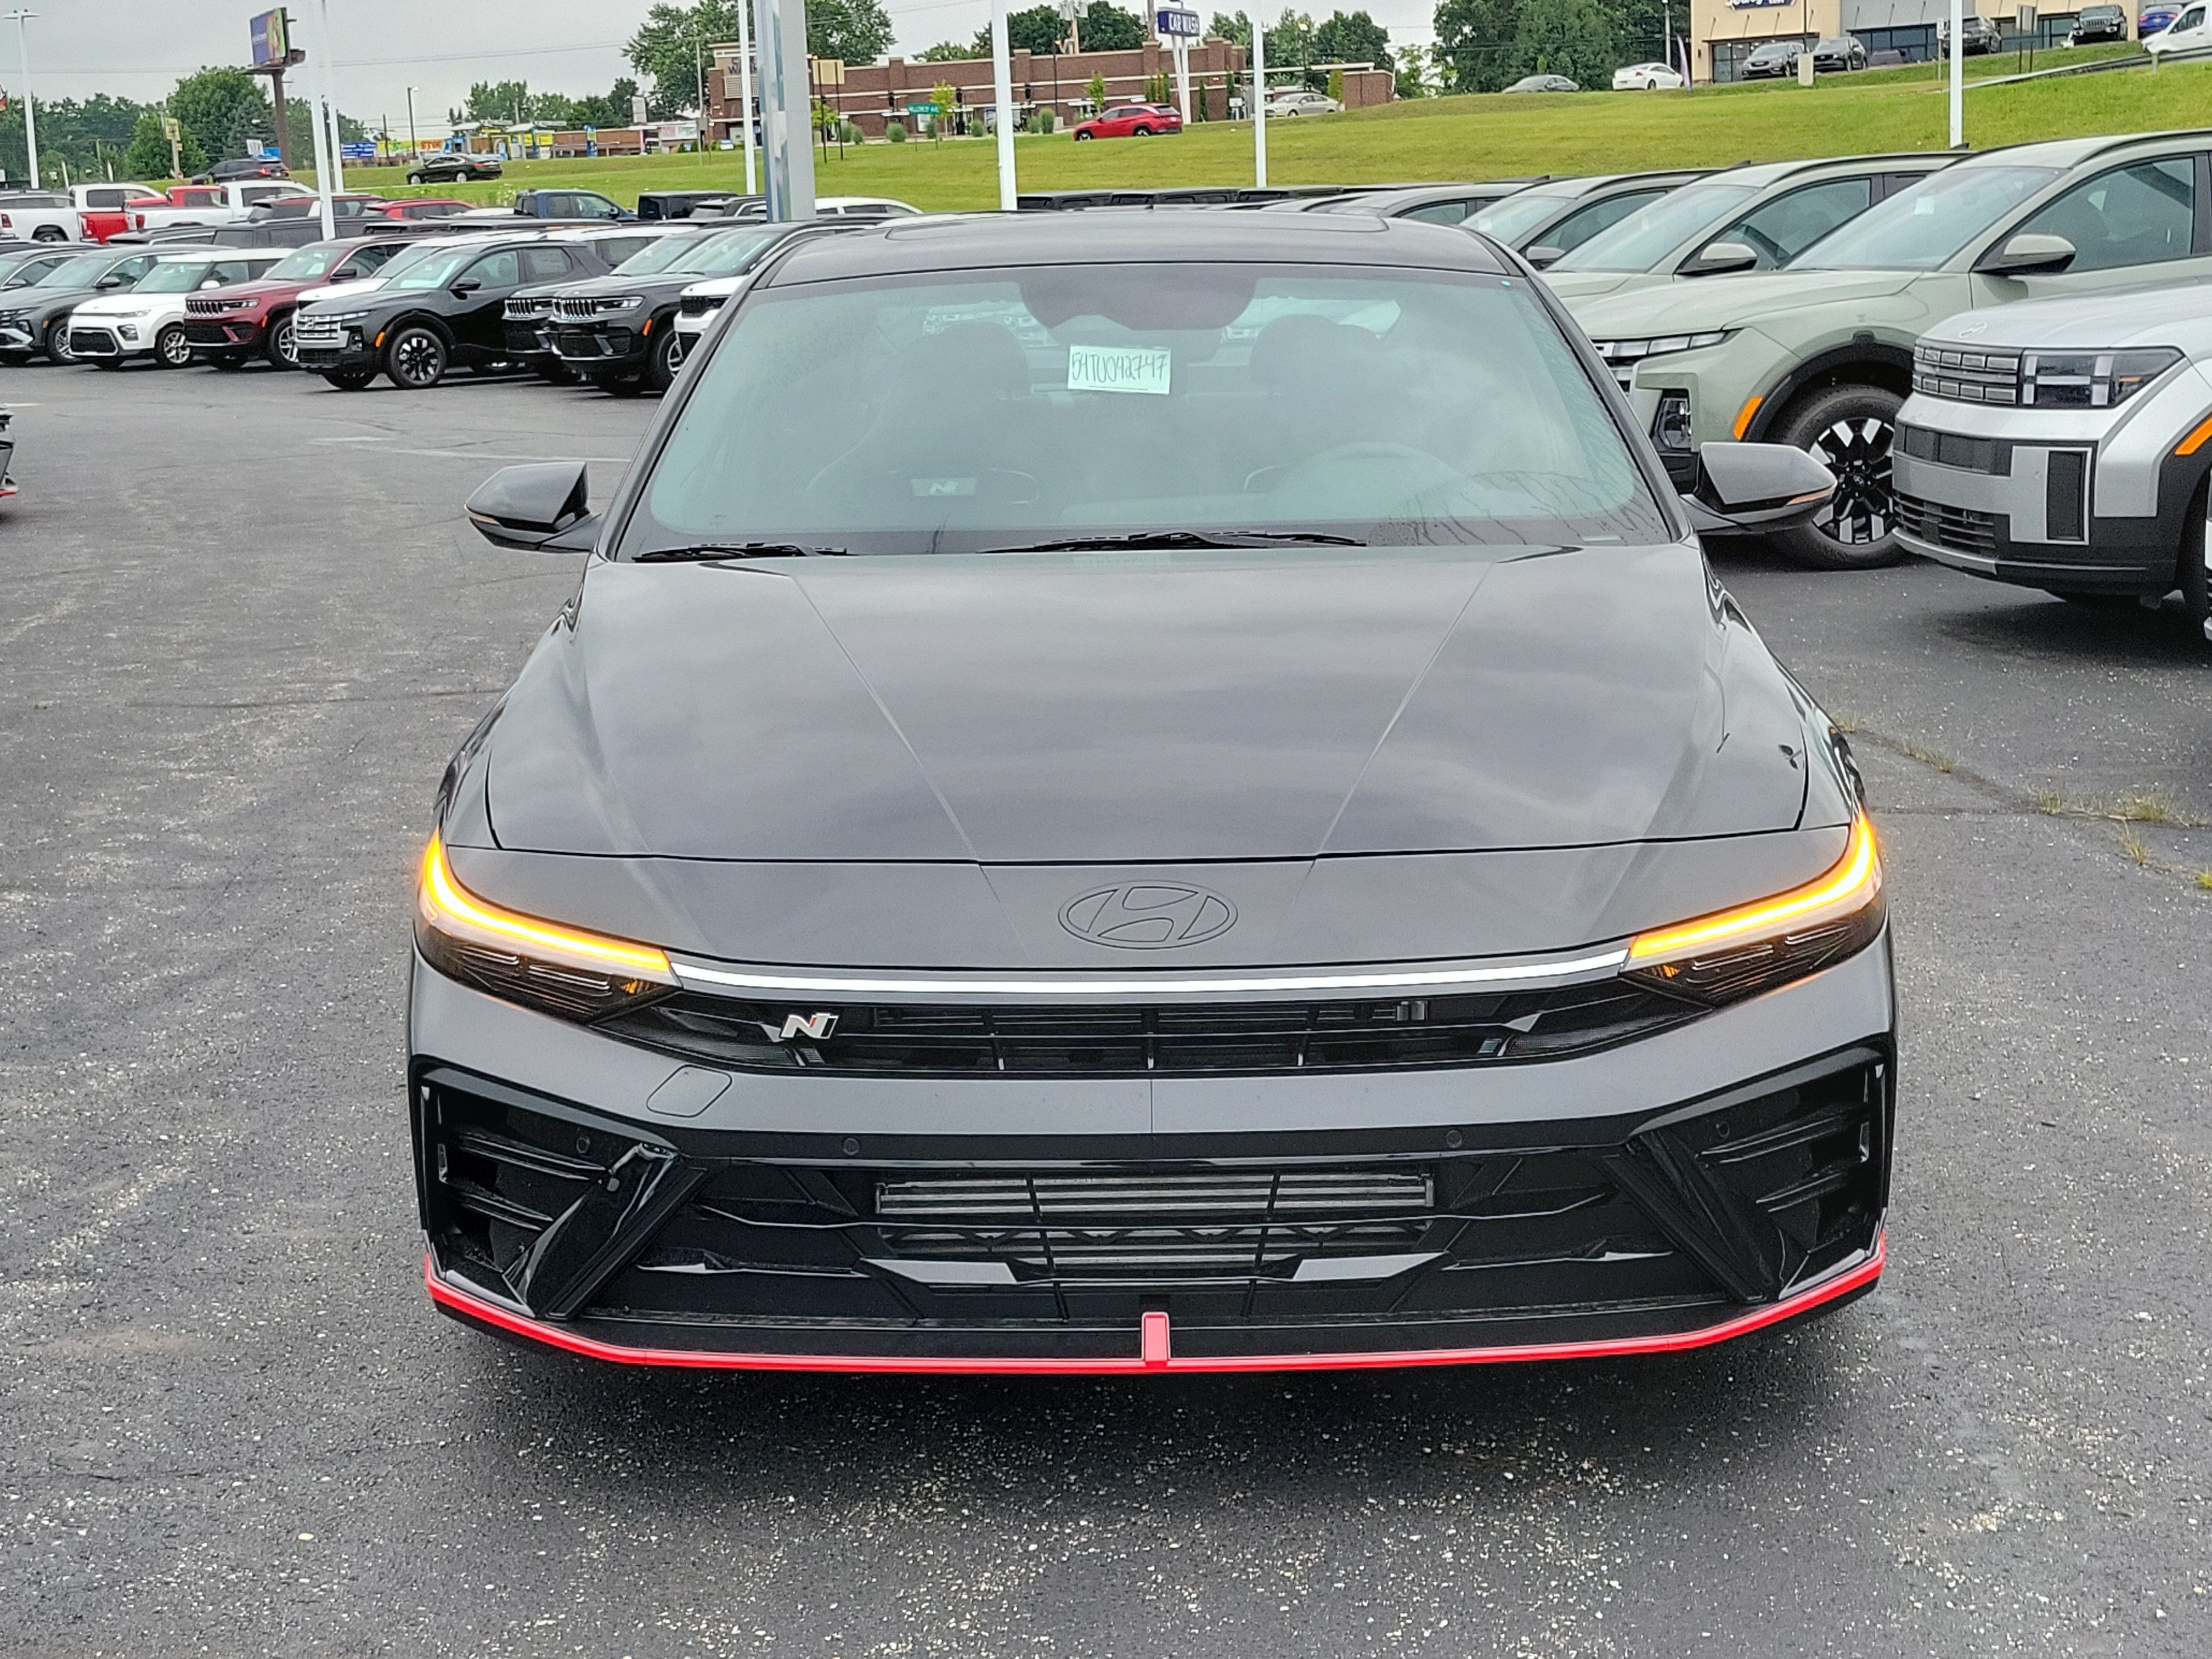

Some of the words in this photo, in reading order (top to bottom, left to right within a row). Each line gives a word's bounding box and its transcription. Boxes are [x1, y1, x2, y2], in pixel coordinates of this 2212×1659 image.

[1169, 13, 1182, 32] CAR
[1182, 15, 1199, 33] WASH
[780, 1012, 839, 1040] N
